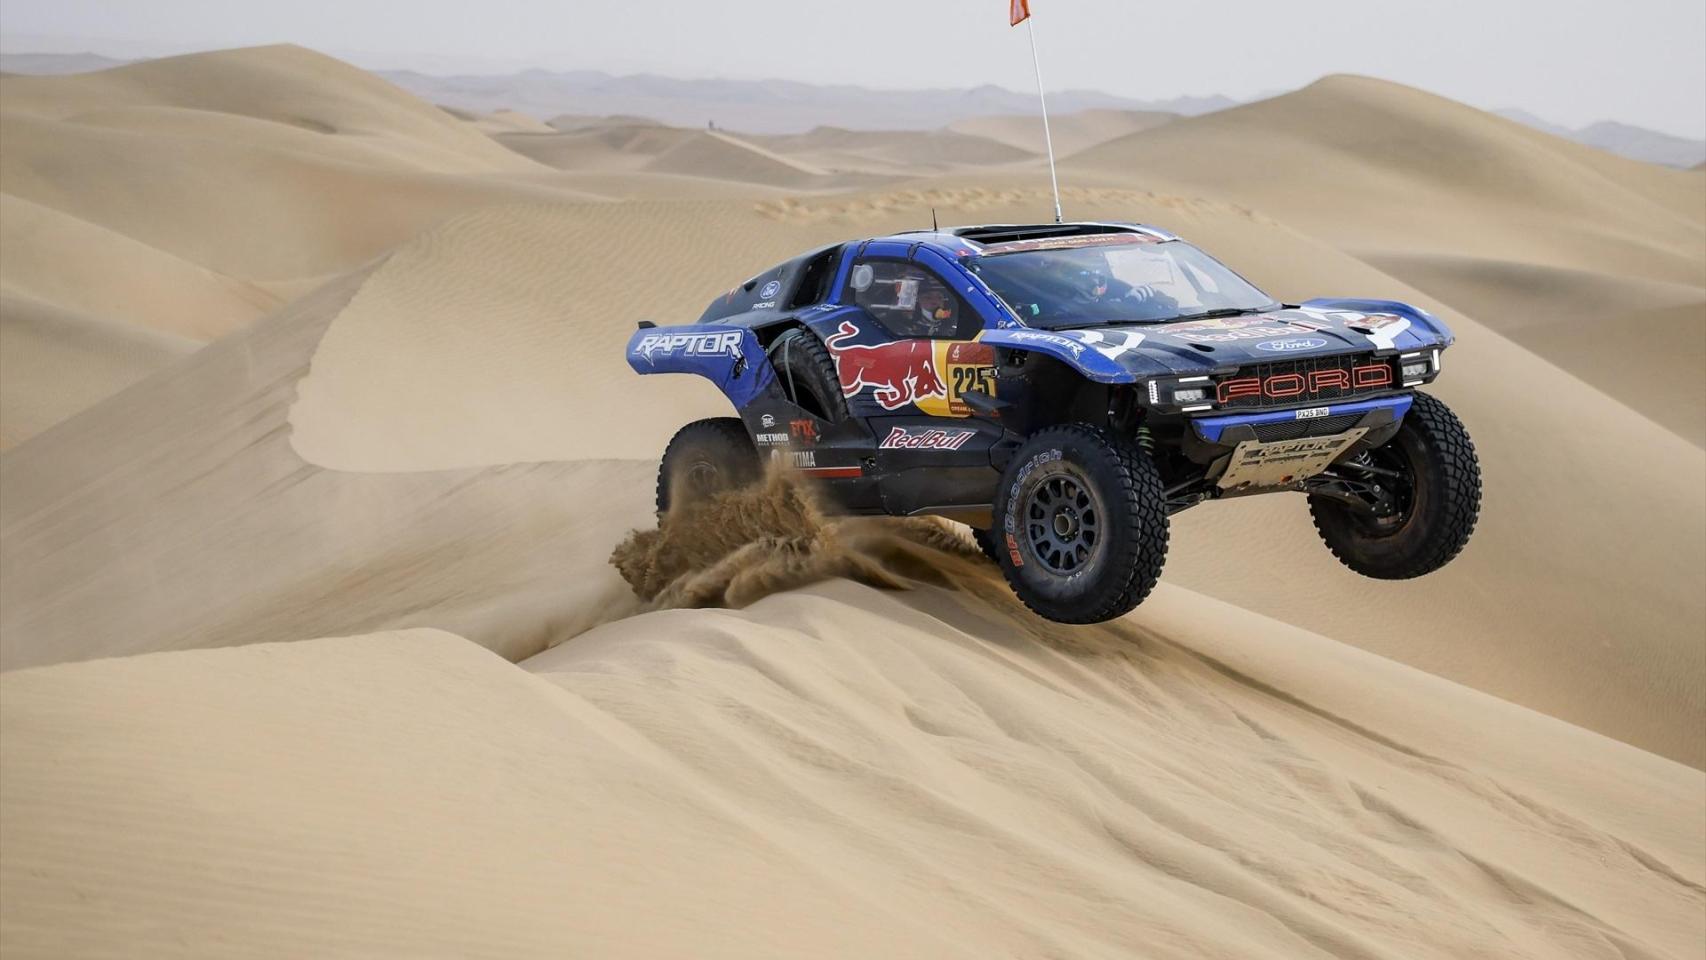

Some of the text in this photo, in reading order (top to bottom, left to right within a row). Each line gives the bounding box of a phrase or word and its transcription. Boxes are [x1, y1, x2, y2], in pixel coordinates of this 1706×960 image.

[752, 301, 776, 309] RACING
[632, 330, 749, 369] RAPTOR
[1008, 331, 1087, 360] RAPTOR
[1270, 338, 1315, 351] Ford
[952, 367, 990, 399] 225
[1216, 364, 1392, 404] FORD
[1297, 409, 1314, 418] PX25
[756, 433, 790, 442] METHOD
[1258, 440, 1330, 456] RAPTOR
